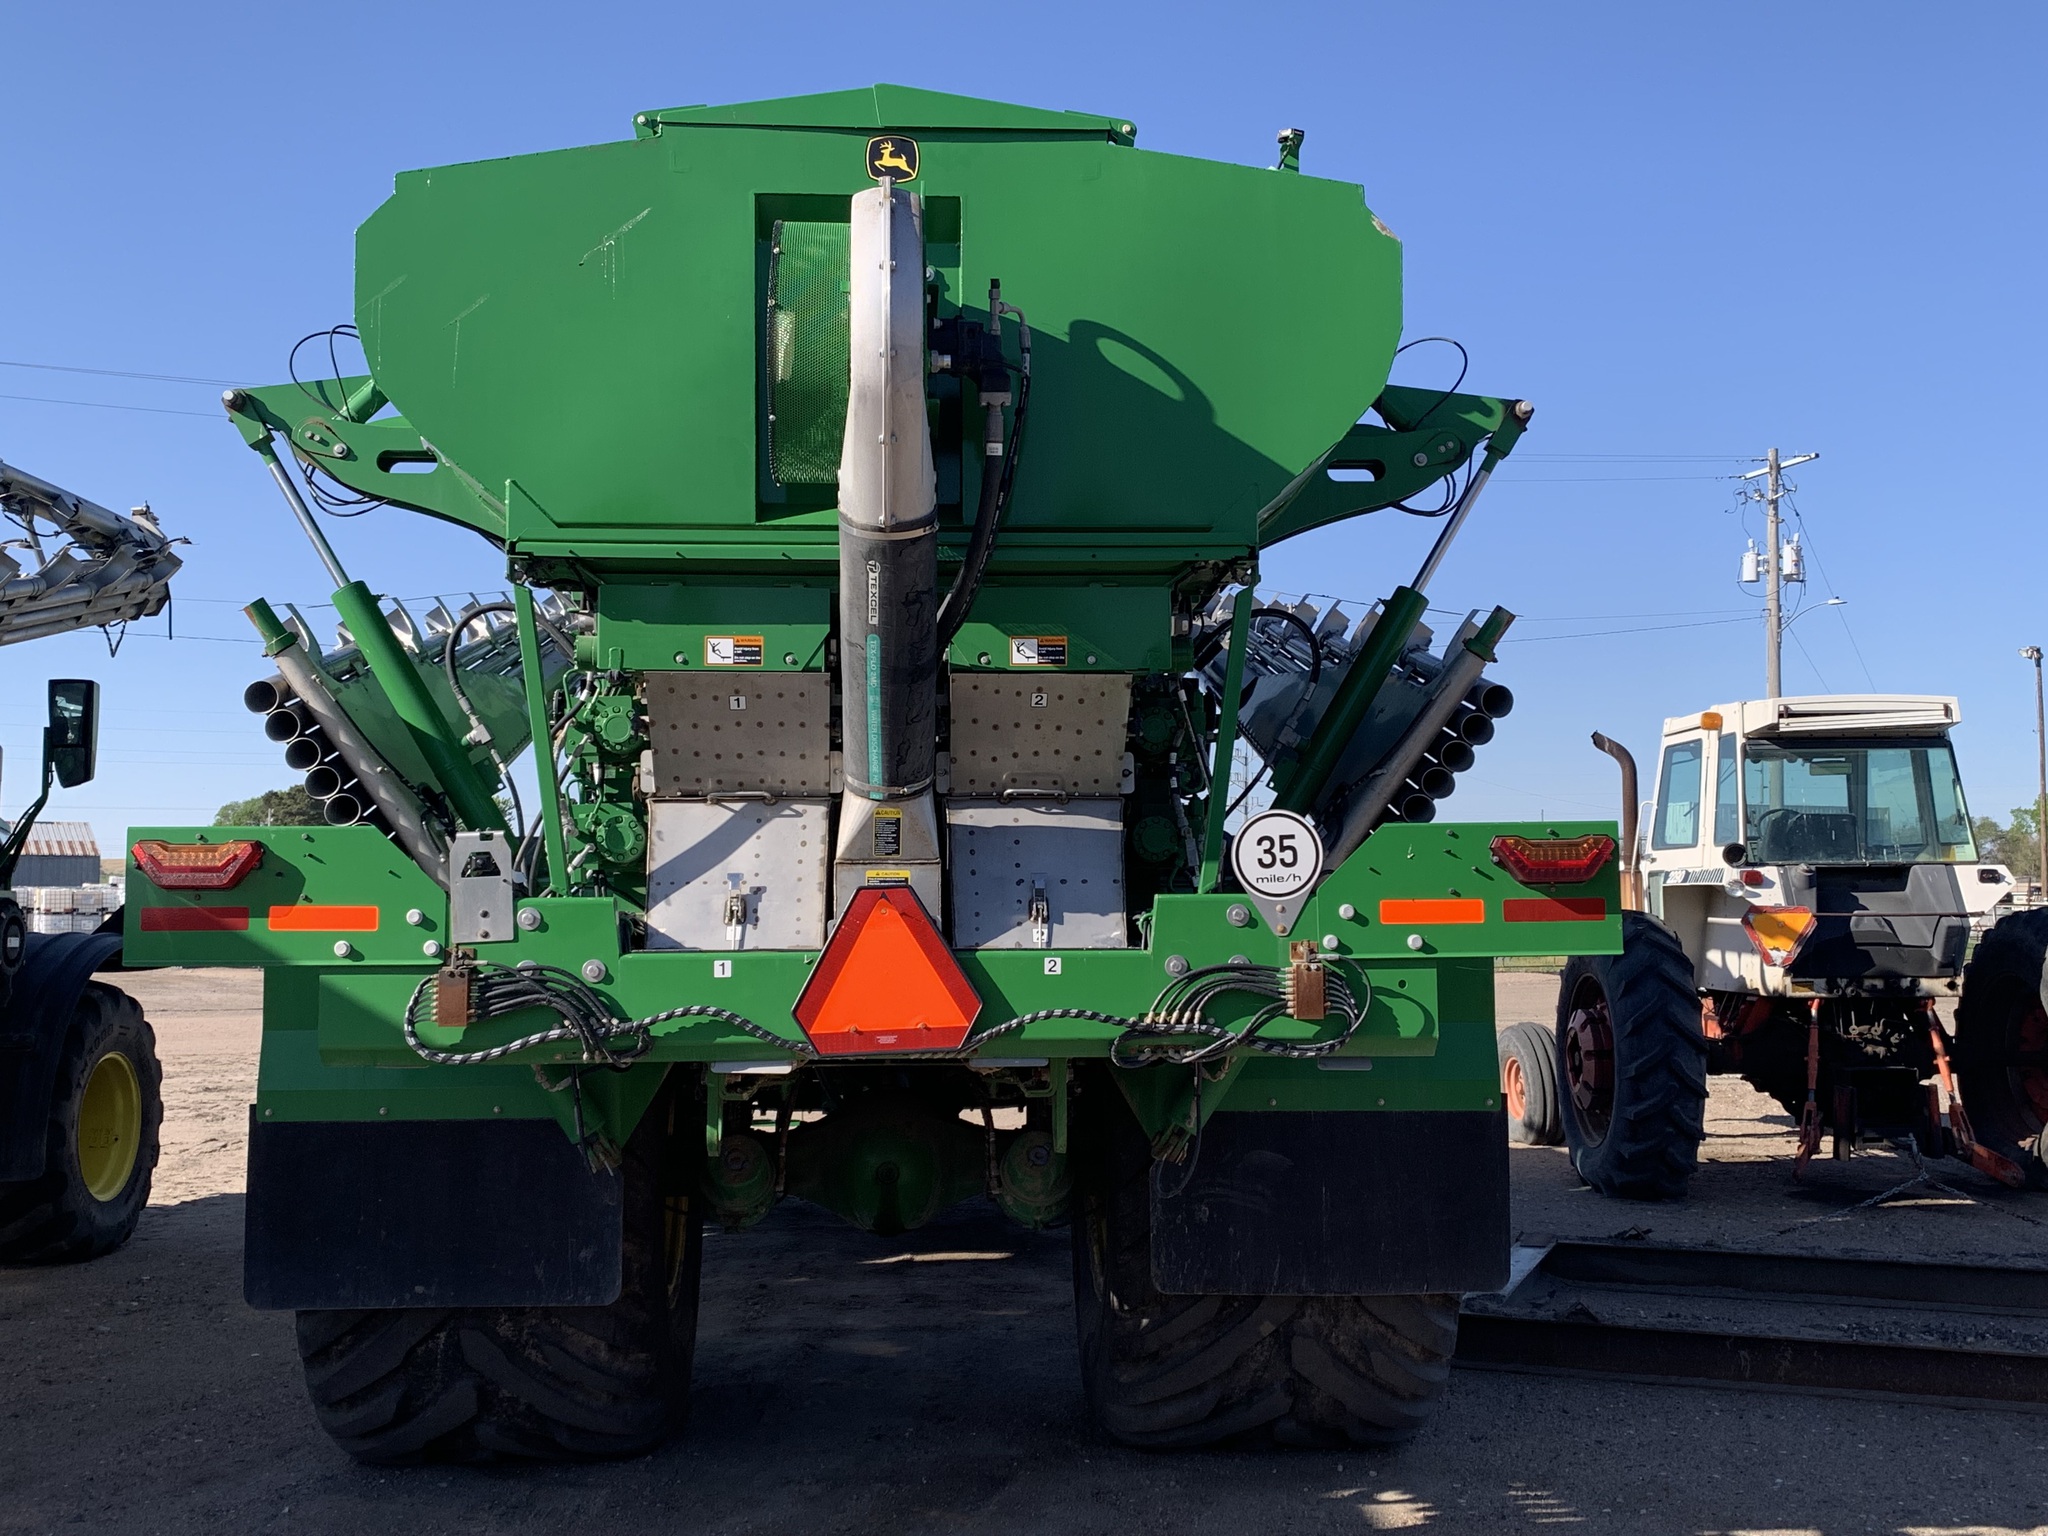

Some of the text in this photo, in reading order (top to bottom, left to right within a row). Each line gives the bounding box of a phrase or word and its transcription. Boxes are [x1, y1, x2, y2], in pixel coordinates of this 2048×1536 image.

[734, 697, 740, 708] 1
[1034, 694, 1044, 705] 2
[871, 734, 879, 773] DISCHARGE
[1256, 834, 1298, 869] 35
[1256, 873, 1302, 884] mile/h
[719, 962, 725, 975] 1
[1048, 959, 1057, 972] 2
